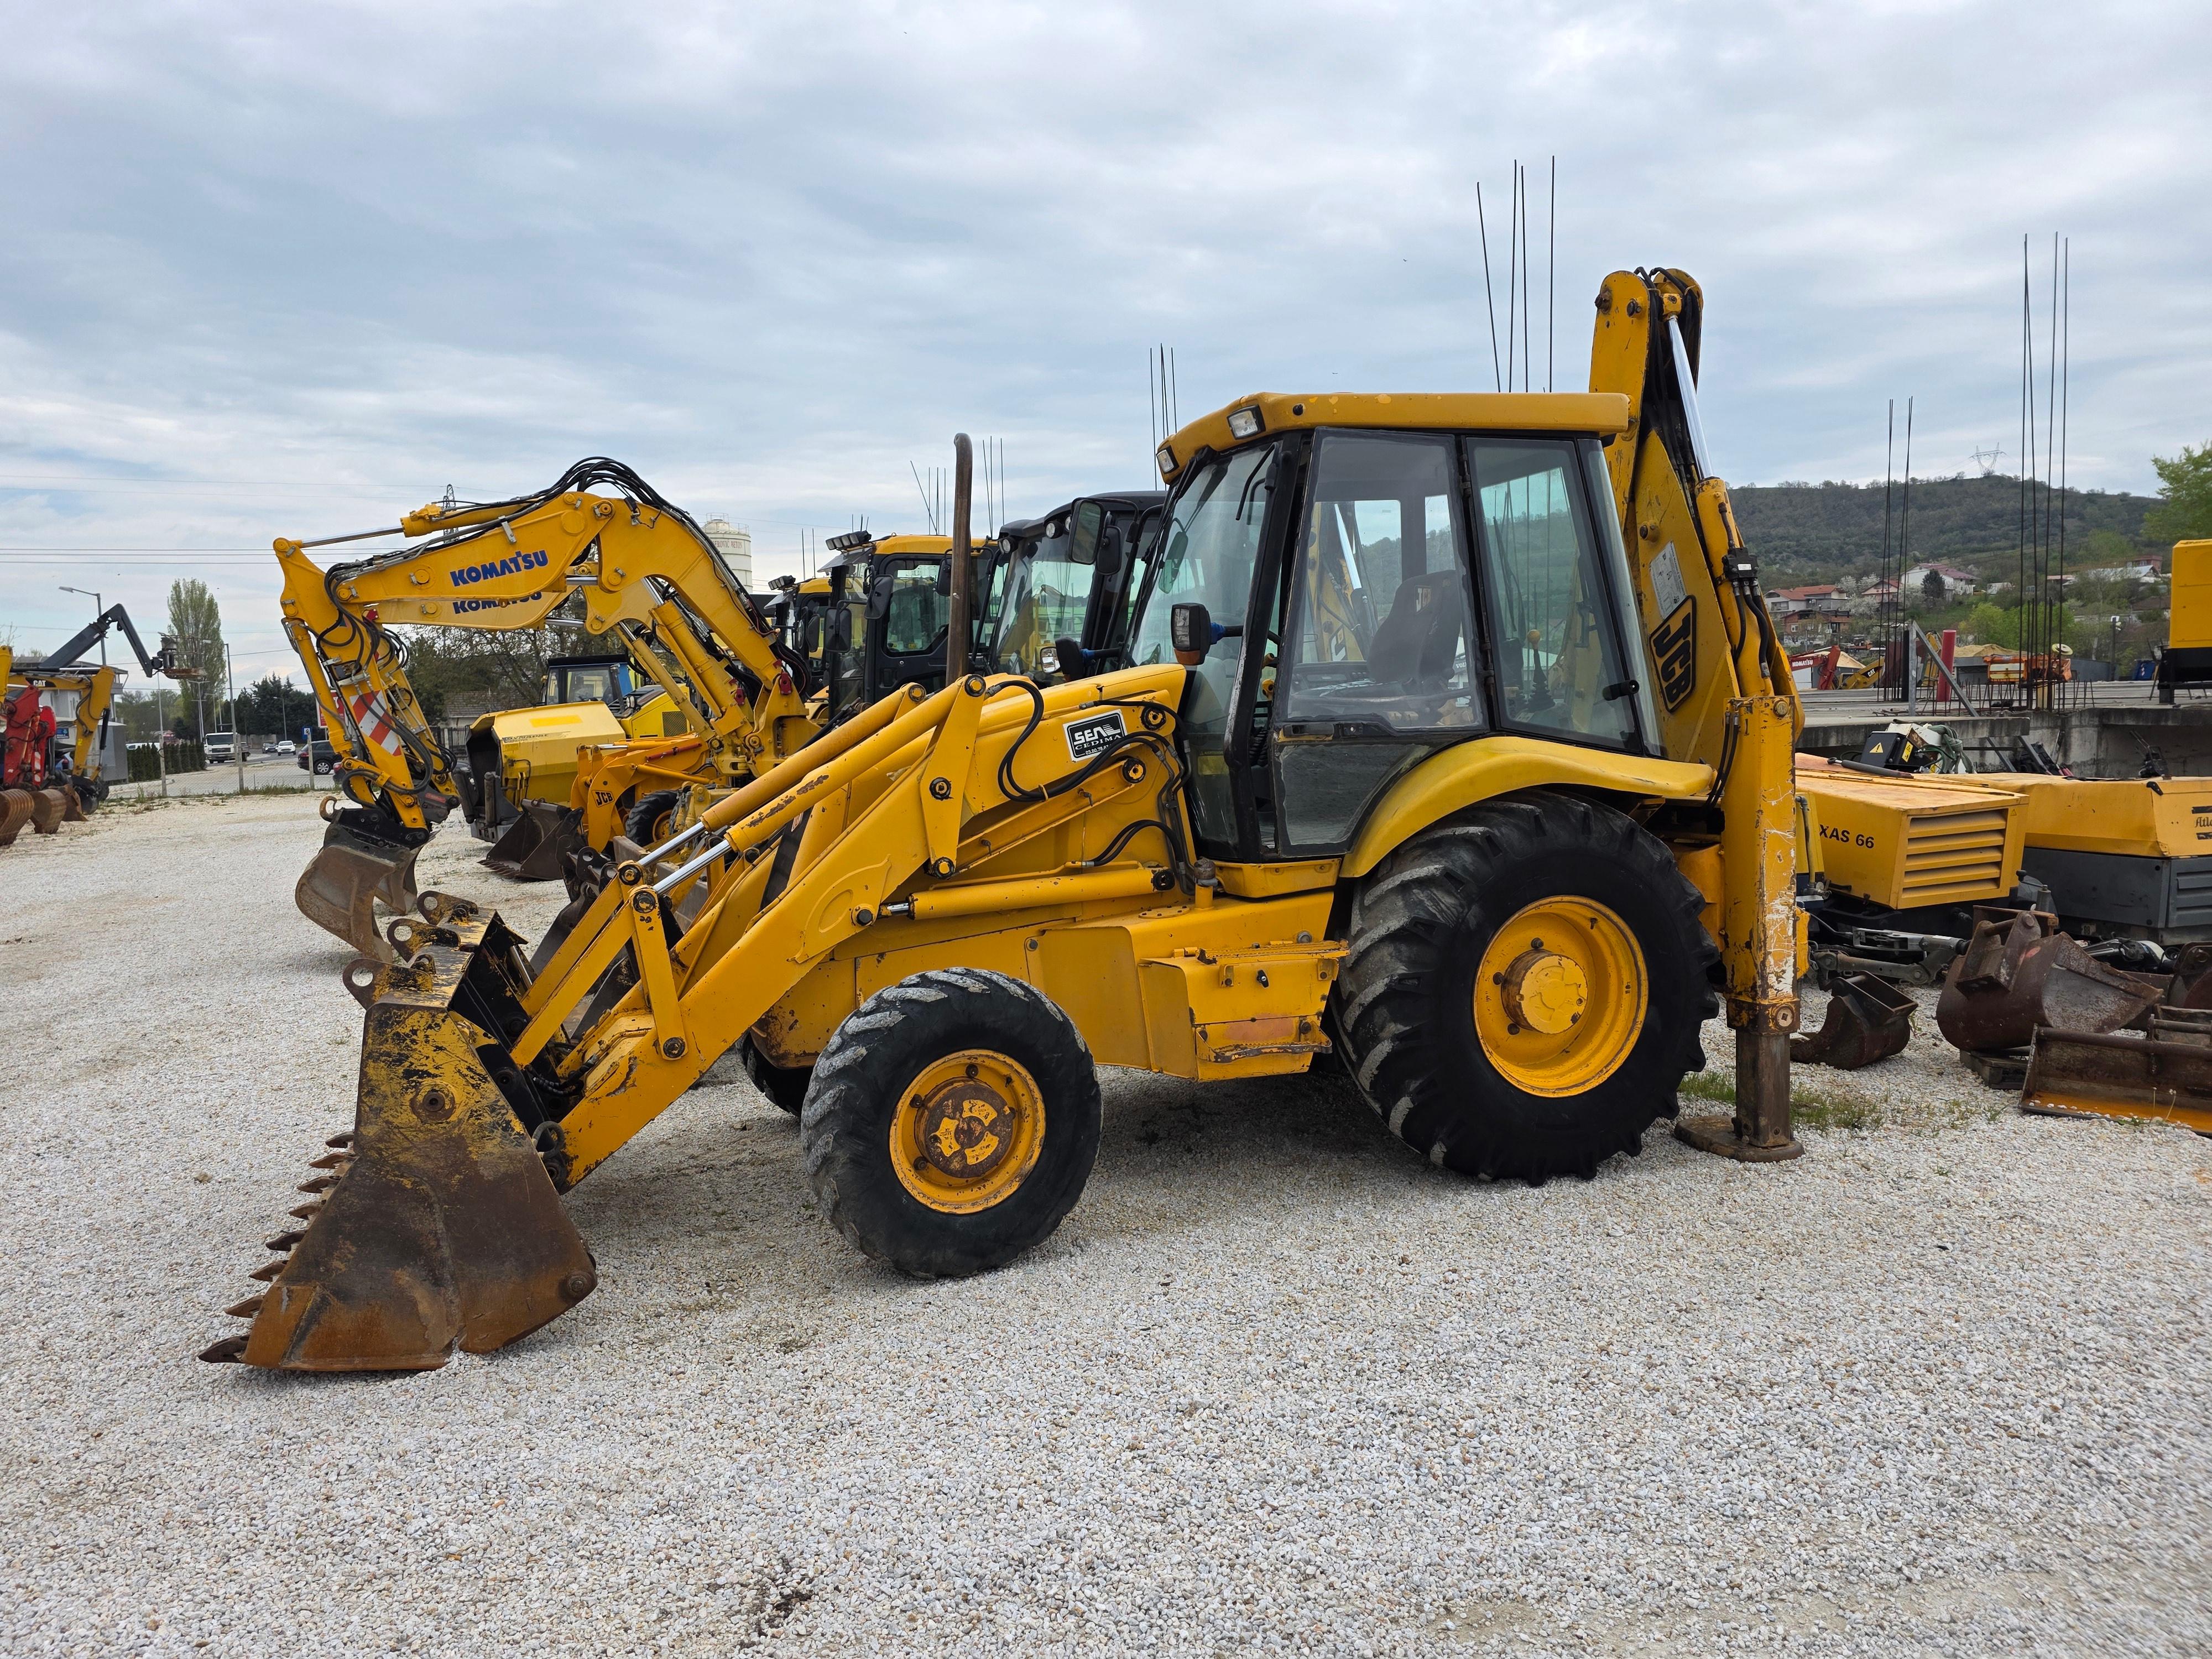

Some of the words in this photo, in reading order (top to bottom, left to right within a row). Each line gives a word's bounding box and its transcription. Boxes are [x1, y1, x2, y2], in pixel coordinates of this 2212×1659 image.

[450, 550, 549, 587] KOMATSU
[453, 592, 542, 614] KOMU
[1653, 612, 1691, 703] JCB
[1075, 734, 1122, 750] CEDIMA
[595, 791, 613, 806] JCB
[1819, 824, 1850, 843] XAS
[1855, 834, 1874, 849] 66
